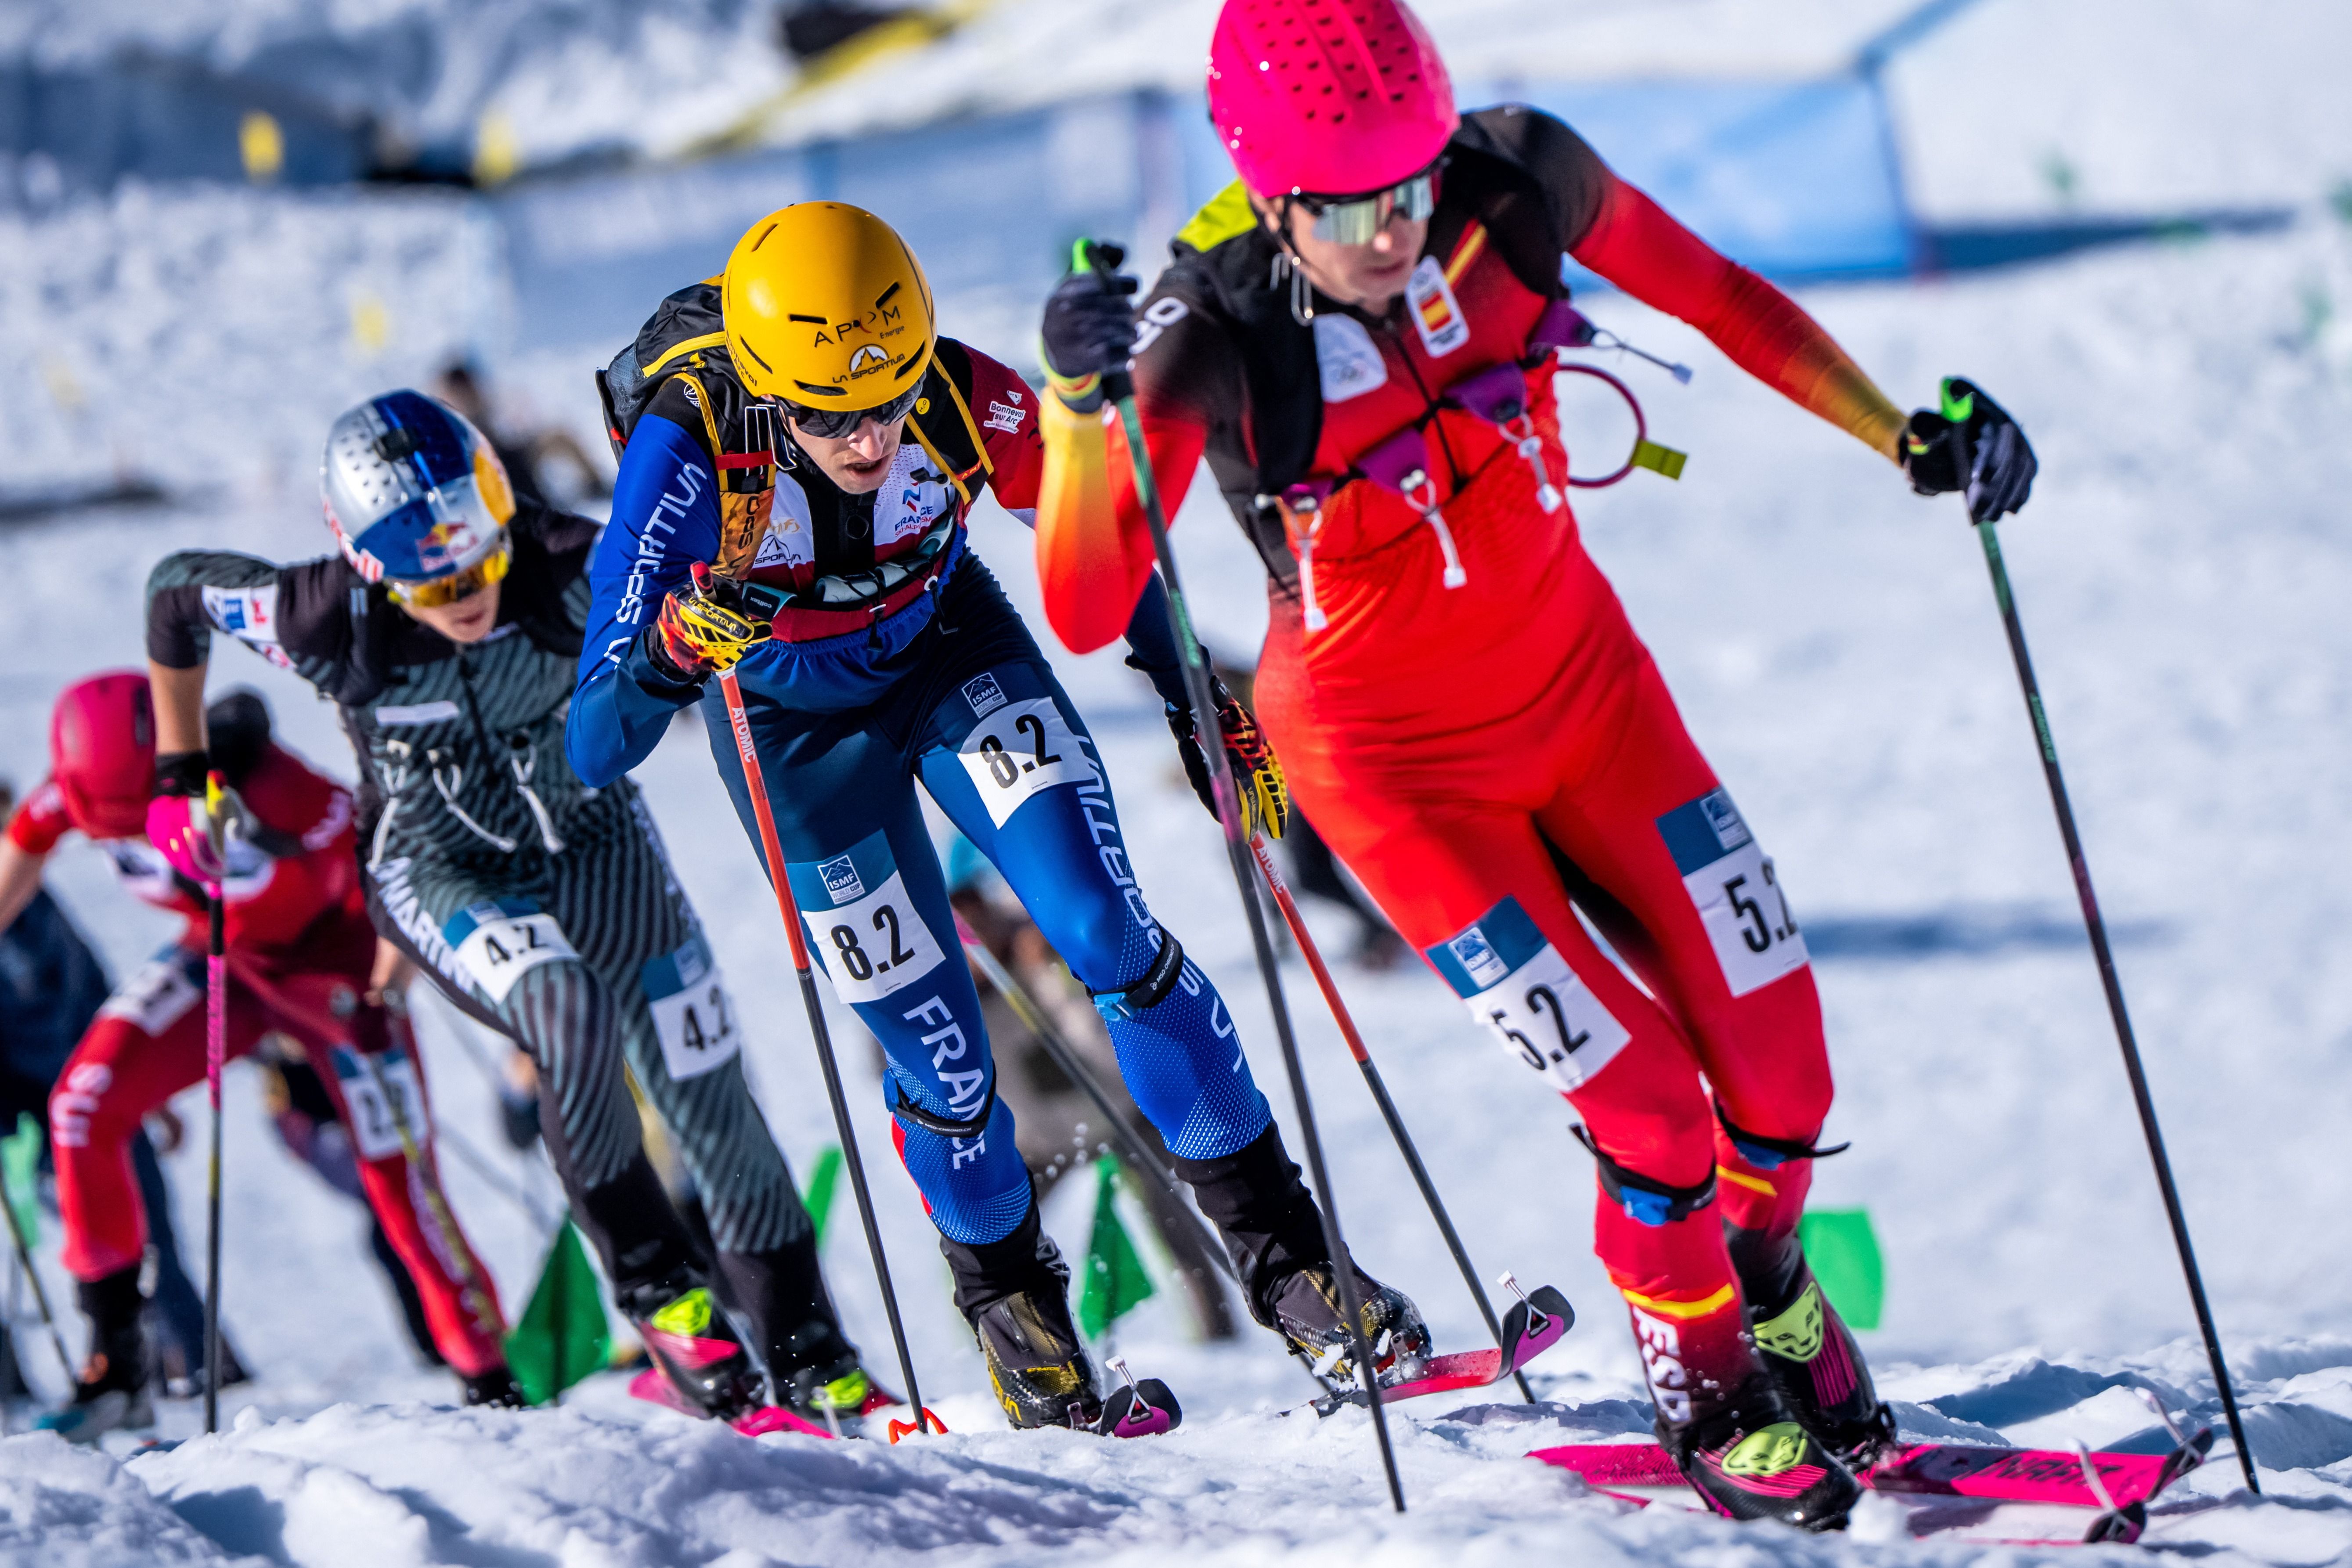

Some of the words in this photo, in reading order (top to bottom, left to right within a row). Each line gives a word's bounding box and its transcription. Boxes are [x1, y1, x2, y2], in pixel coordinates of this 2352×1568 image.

[850, 353, 905, 380] SPORTIVA
[991, 402, 1024, 418] Bonneval
[1005, 416, 1018, 425] Arc
[616, 462, 707, 625] SPORTIVA
[972, 686, 996, 705] ISMF
[732, 706, 756, 763] ATOMIC
[980, 714, 1063, 789] 8.2
[829, 872, 854, 890] ISMF
[831, 888, 850, 898] WORLD
[850, 883, 860, 892] CUP
[1256, 845, 1286, 894] ATOMIC
[485, 923, 549, 966] 4.2
[830, 904, 916, 981] 8.2
[1490, 982, 1592, 1071] 5.2
